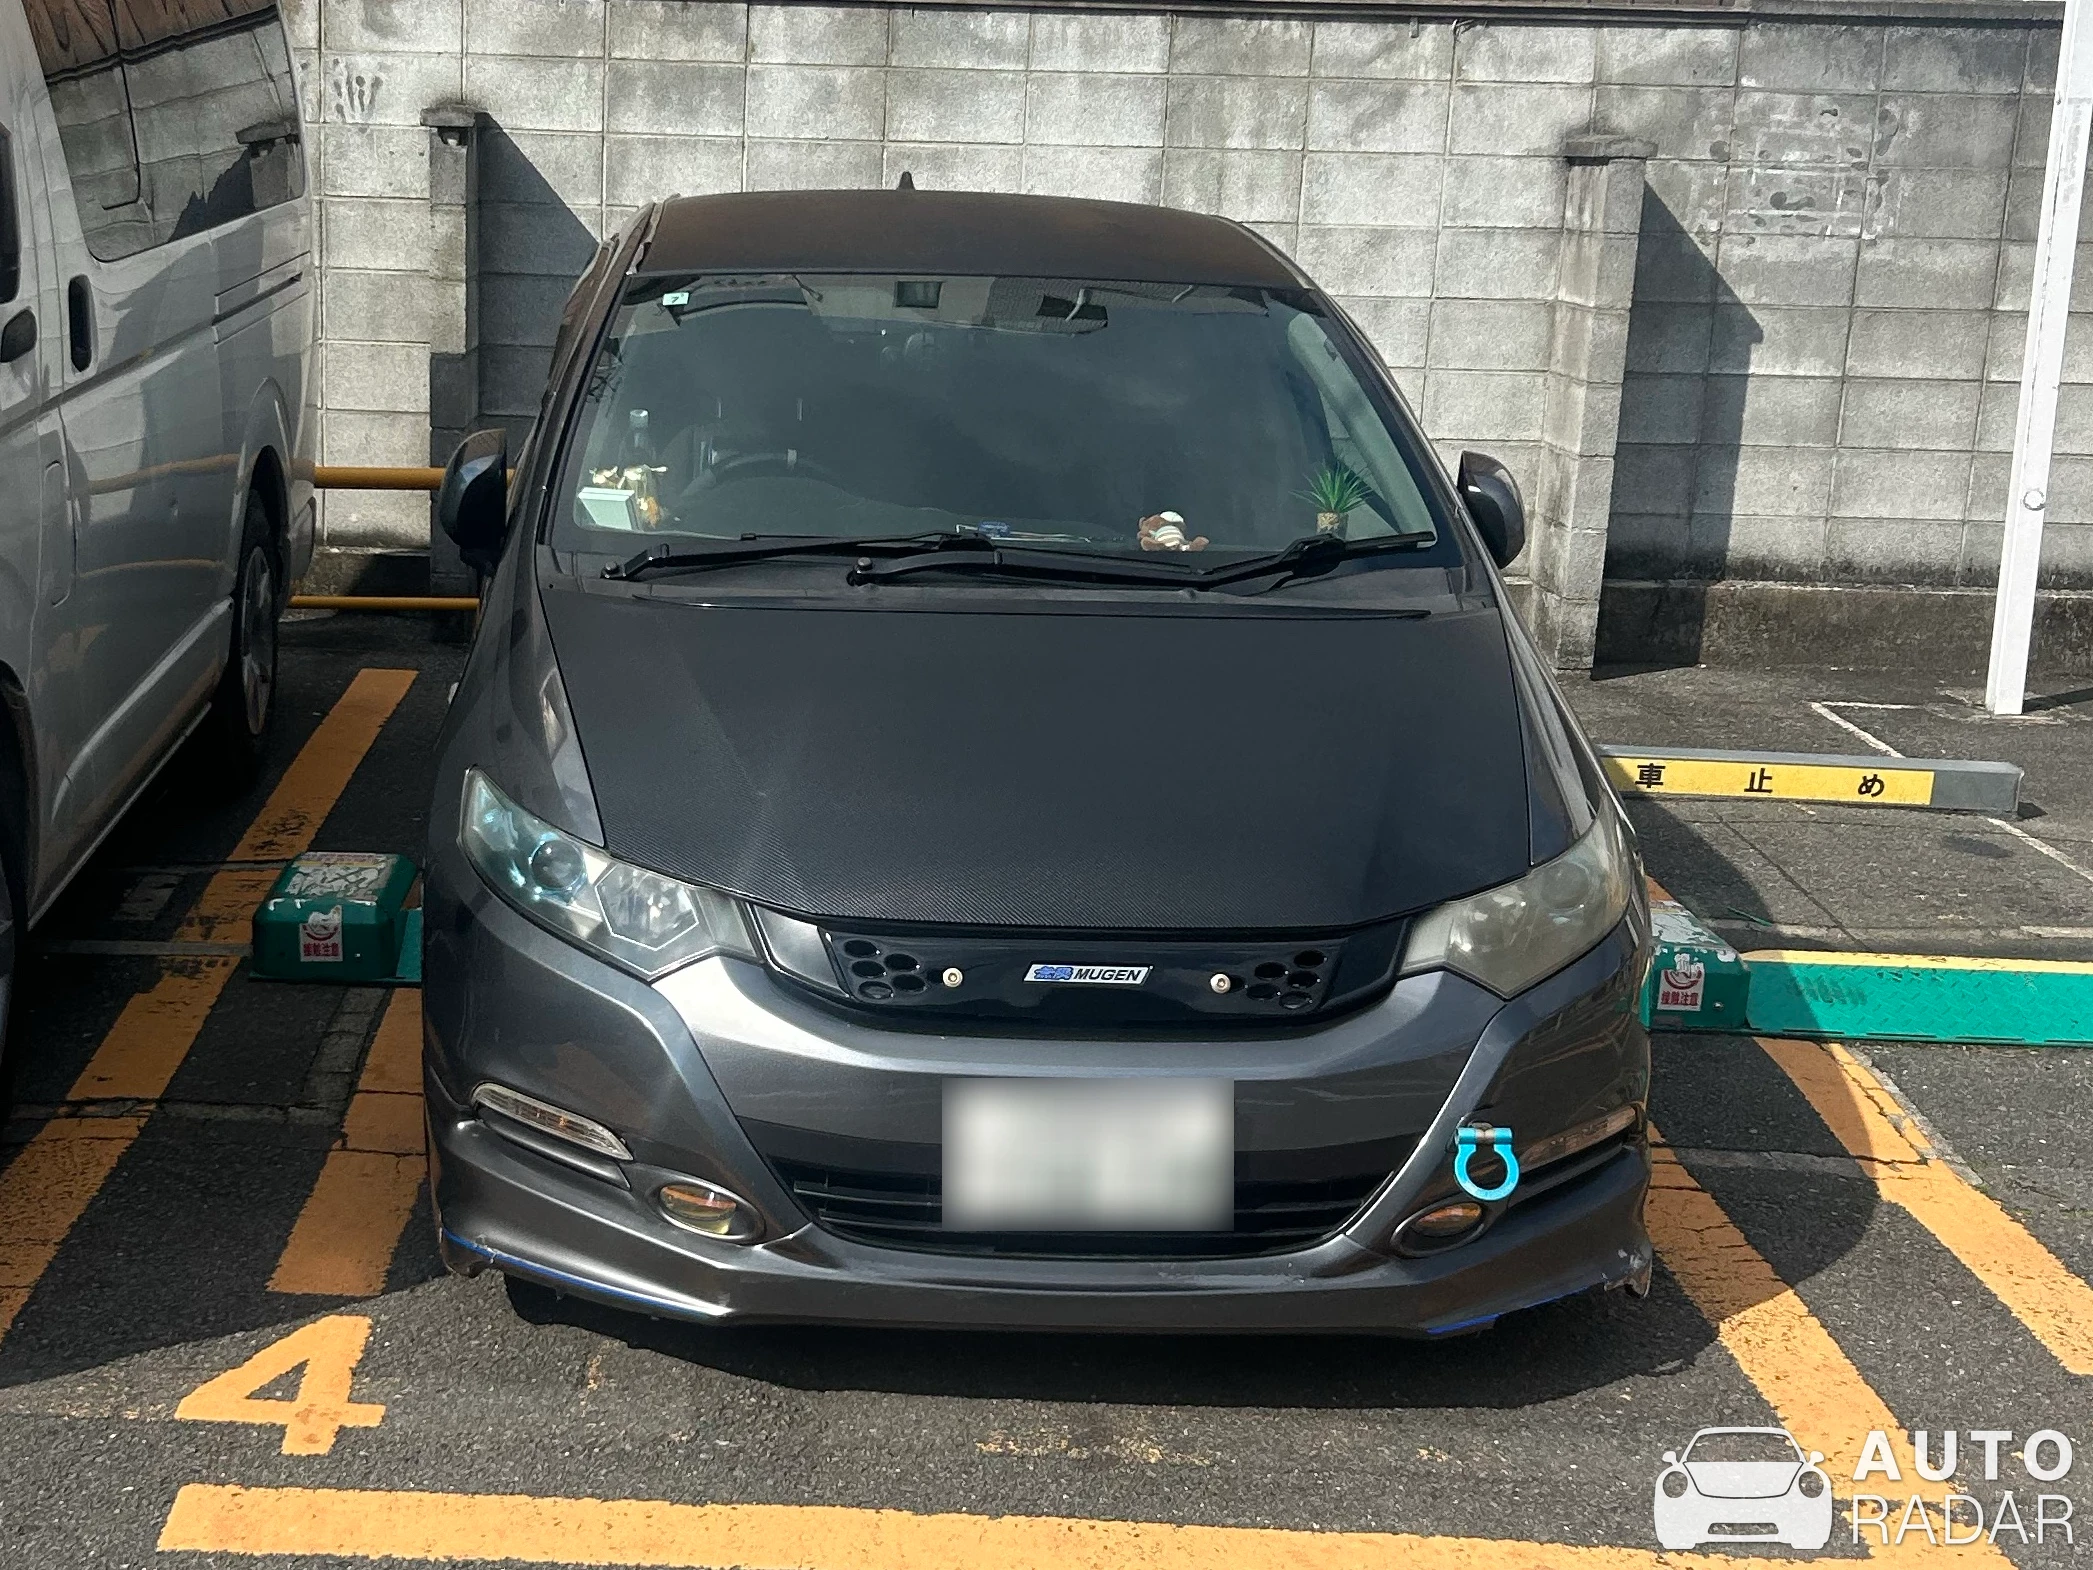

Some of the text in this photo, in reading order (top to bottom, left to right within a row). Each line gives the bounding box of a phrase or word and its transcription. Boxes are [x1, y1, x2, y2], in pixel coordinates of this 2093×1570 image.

[1635, 762, 1885, 797] 車止め
[1074, 968, 1141, 981] MUGEN
[174, 1315, 387, 1456] 4
